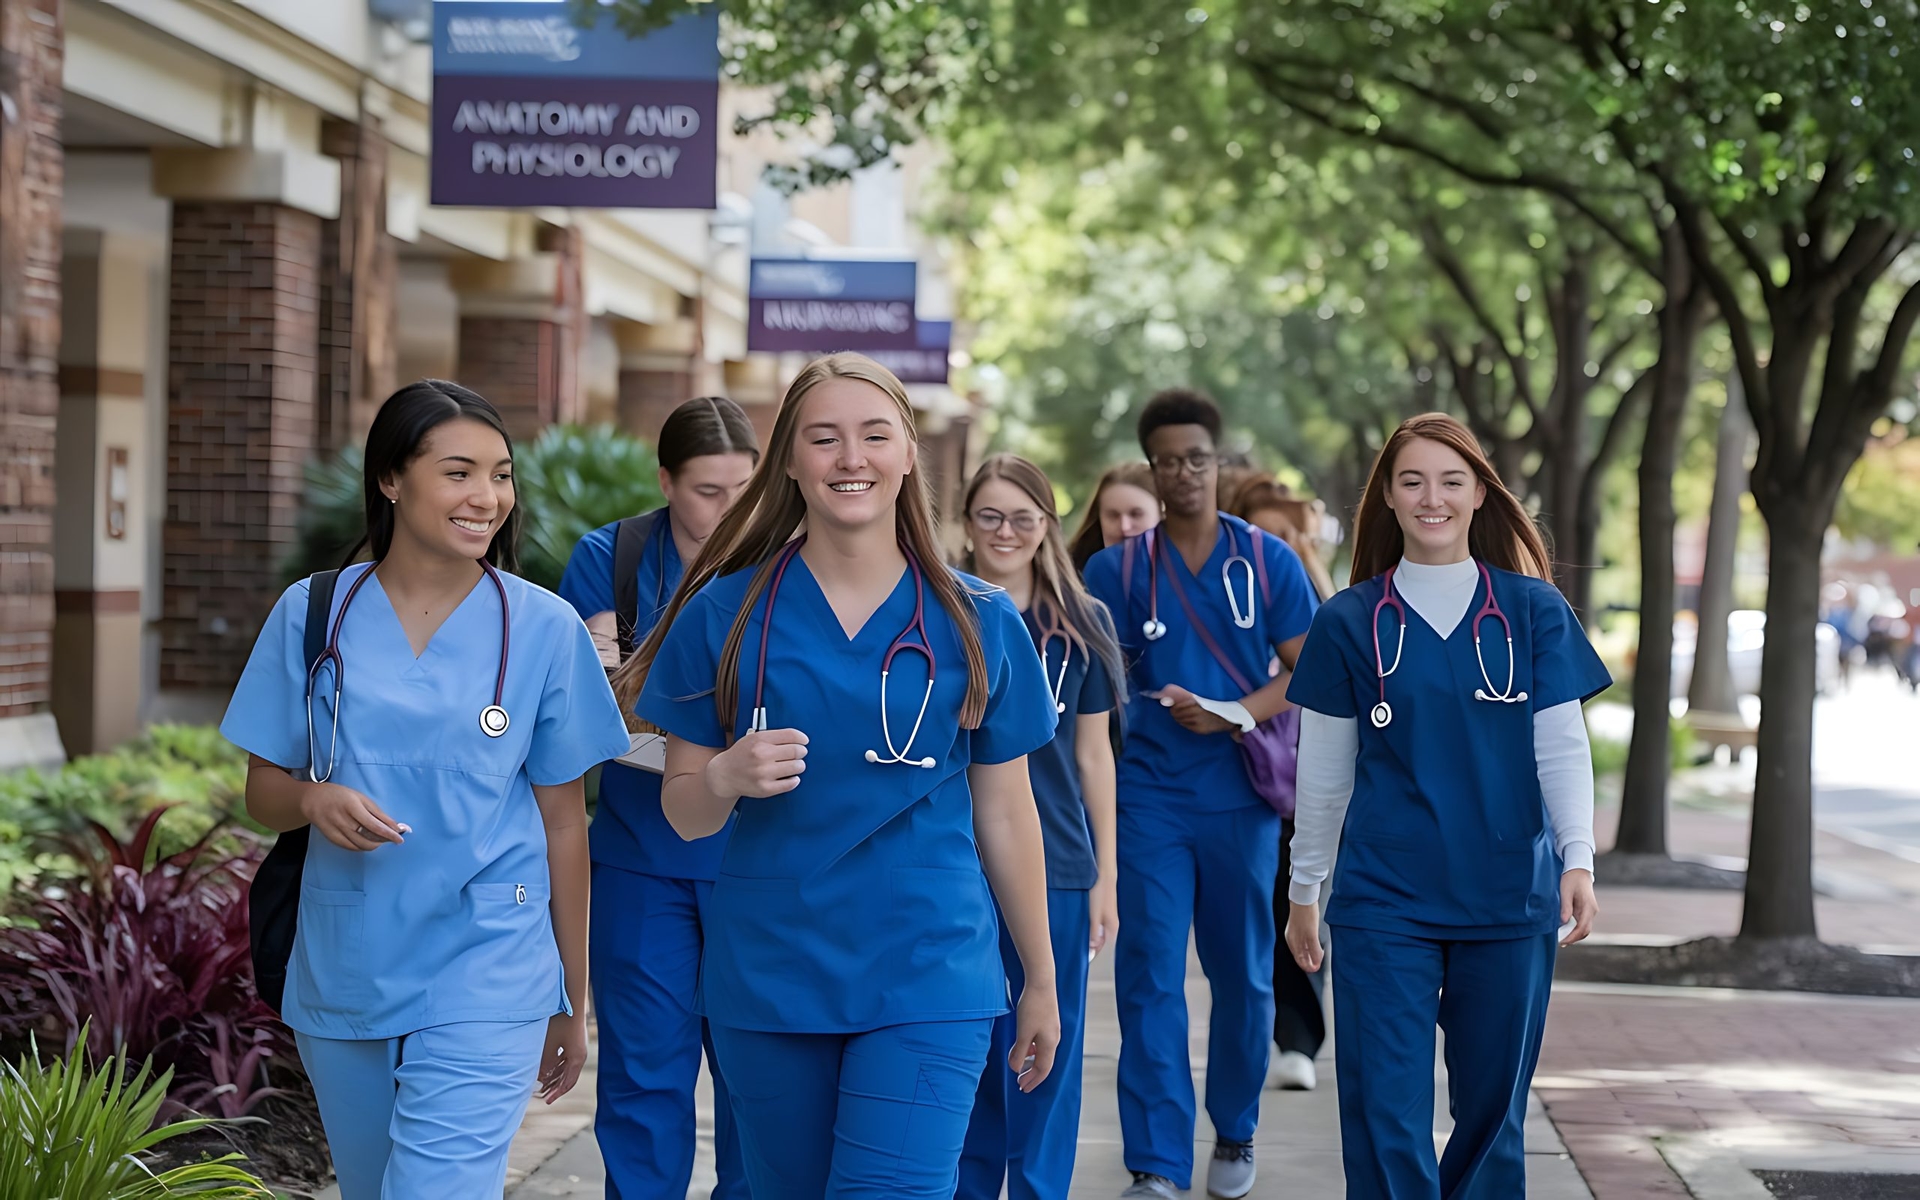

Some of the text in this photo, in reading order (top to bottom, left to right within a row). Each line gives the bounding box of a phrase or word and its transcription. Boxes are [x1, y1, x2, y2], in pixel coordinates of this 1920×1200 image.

[452, 100, 700, 139] ANATOMY AND
[472, 141, 681, 179] PHYSIOLOGY
